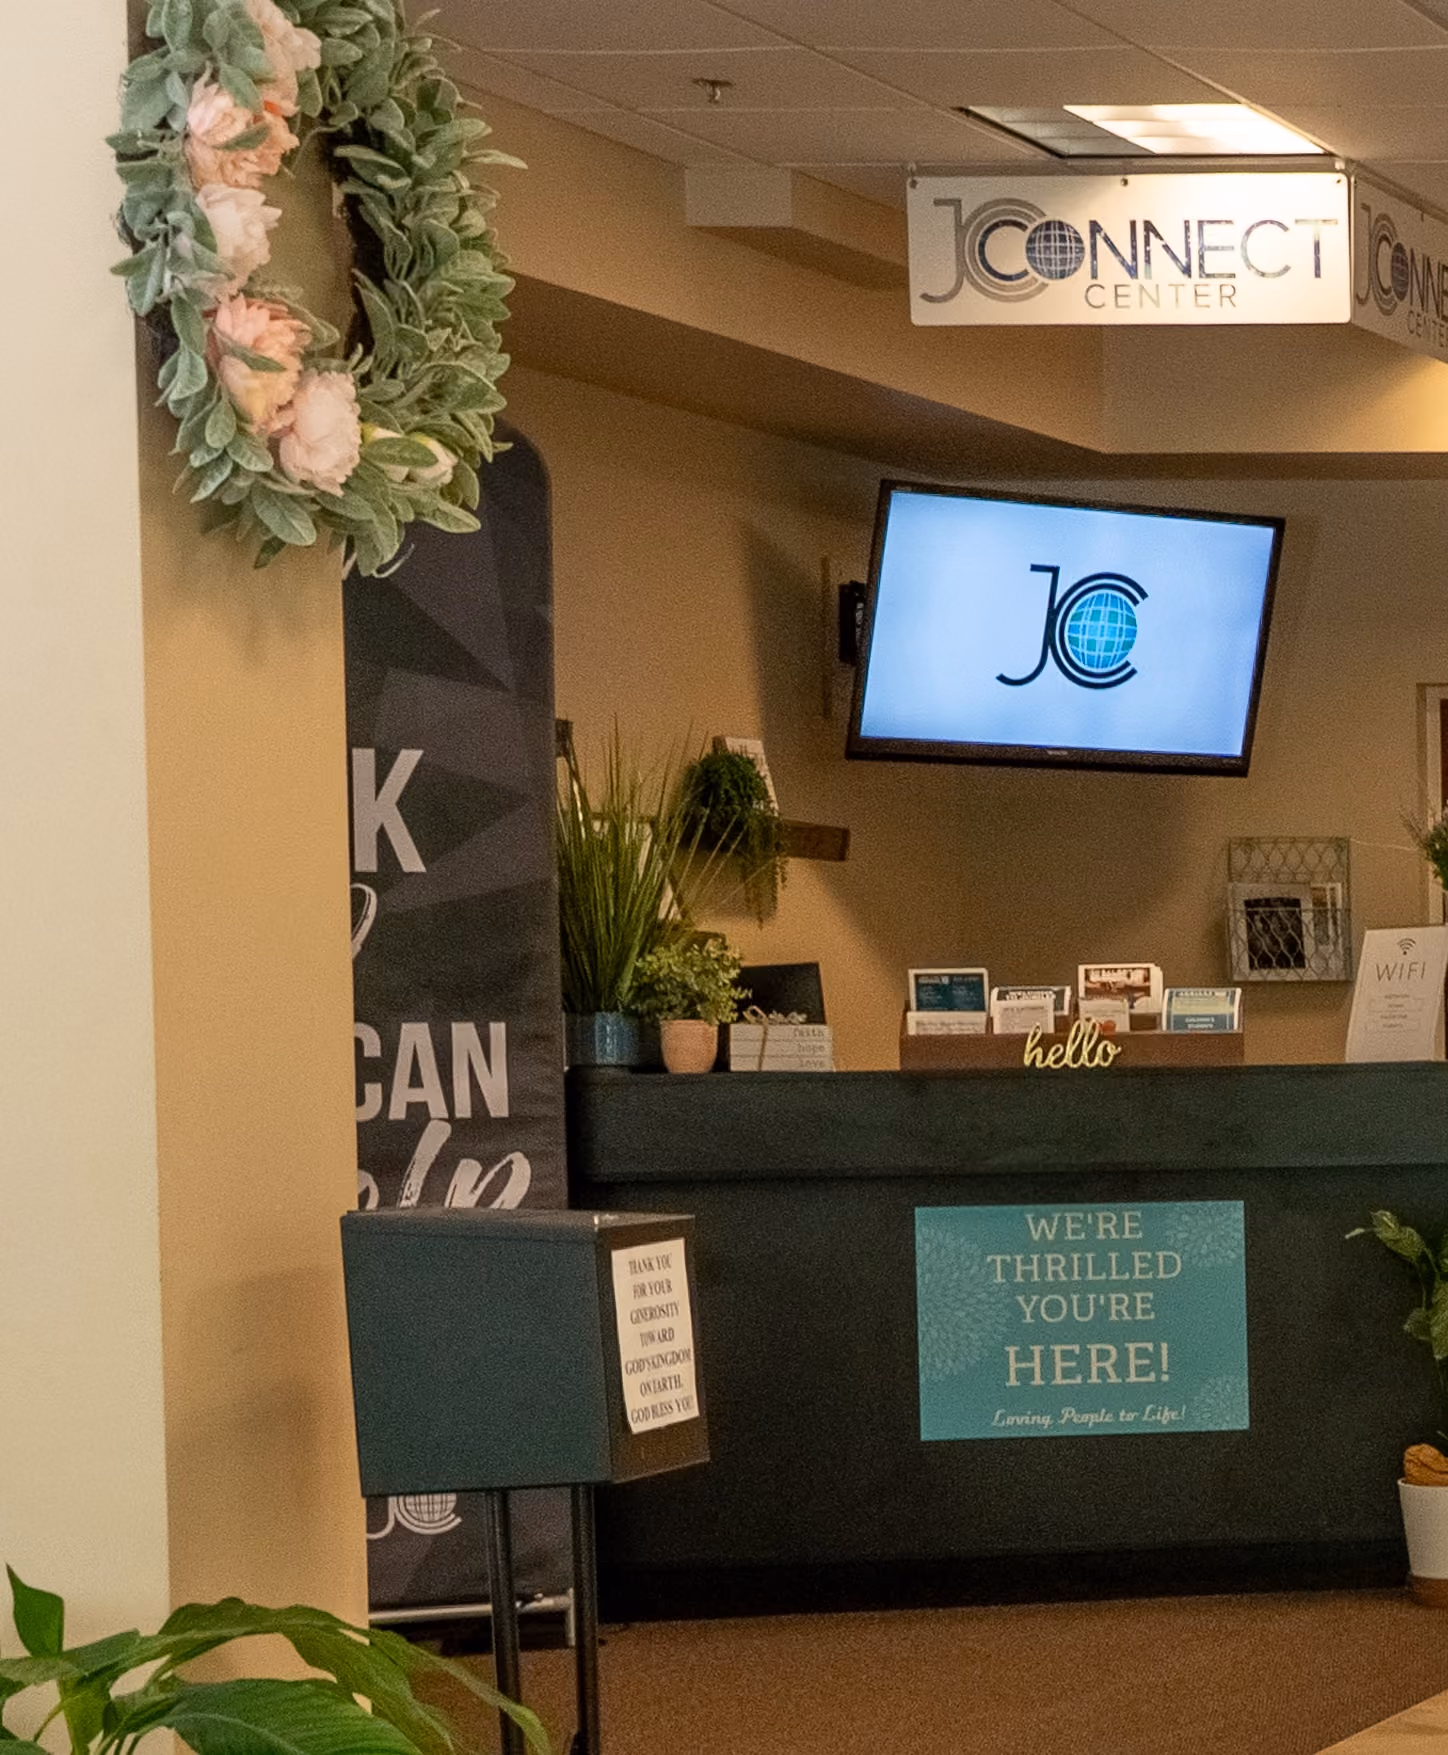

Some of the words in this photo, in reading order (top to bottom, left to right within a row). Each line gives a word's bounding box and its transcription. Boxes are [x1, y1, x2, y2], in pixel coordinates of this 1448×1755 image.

[1085, 283, 1238, 309] CENTER
[1376, 961, 1426, 981] WIFI
[793, 1027, 825, 1038] faith
[1023, 1016, 1121, 1069] hello
[798, 1042, 826, 1055] hope
[1025, 1211, 1144, 1241] WE'RE
[628, 1256, 655, 1276] THANK
[655, 1253, 673, 1271] YOU
[986, 1250, 1182, 1284] THRILLED
[633, 1282, 648, 1300] FOR
[648, 1278, 673, 1297] YOUR
[630, 1302, 680, 1325] GENEROSITY
[1016, 1291, 1156, 1324] YOU'RE
[640, 1327, 675, 1347] TOWARD
[625, 1357, 650, 1376] GOD'S
[648, 1348, 691, 1370] KINGDOM
[1004, 1341, 1170, 1387] HERE!
[640, 1379, 654, 1397] ON
[631, 1406, 651, 1425] GOD
[651, 1400, 674, 1420] BLESS
[992, 1408, 1052, 1429] Loving
[1058, 1406, 1115, 1426] People
[1119, 1407, 1139, 1421] to
[1142, 1403, 1187, 1425] Life!
